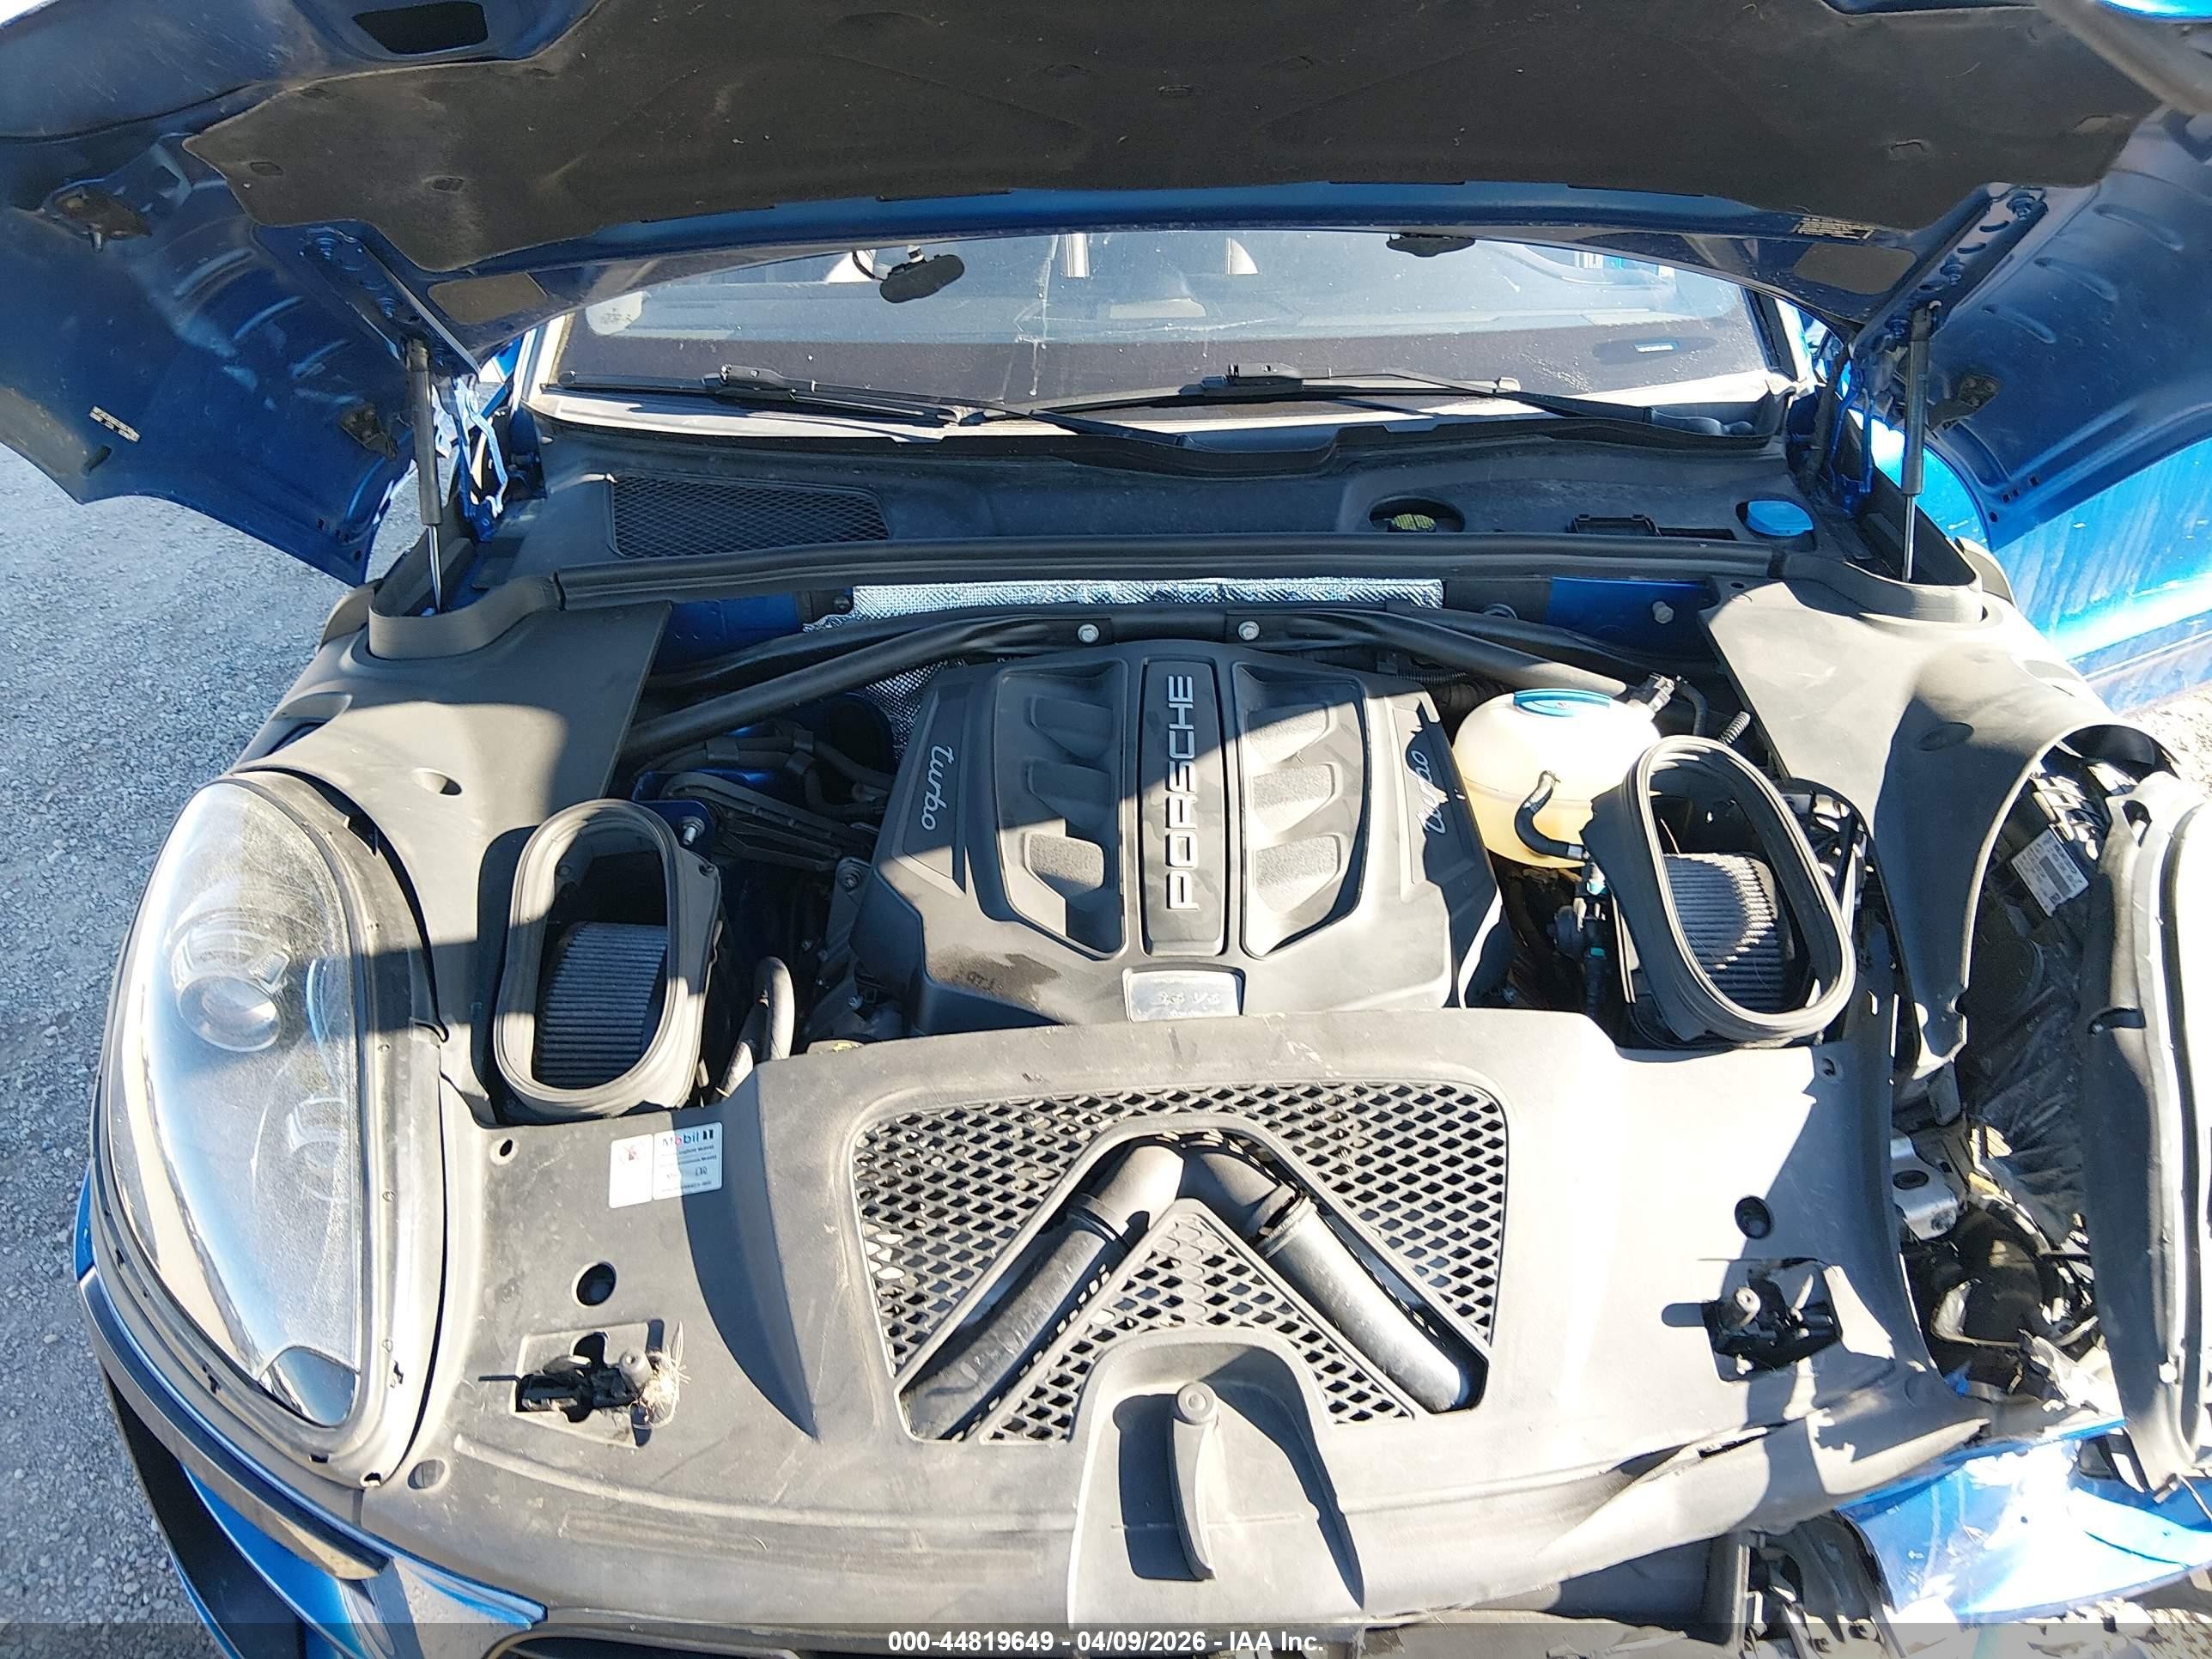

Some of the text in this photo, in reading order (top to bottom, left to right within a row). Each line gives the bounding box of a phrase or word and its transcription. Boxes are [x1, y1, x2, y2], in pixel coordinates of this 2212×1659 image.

[921, 745, 954, 830] turbo
[1168, 675, 1199, 910] PORSCHE
[662, 1131, 699, 1147] Mobil
